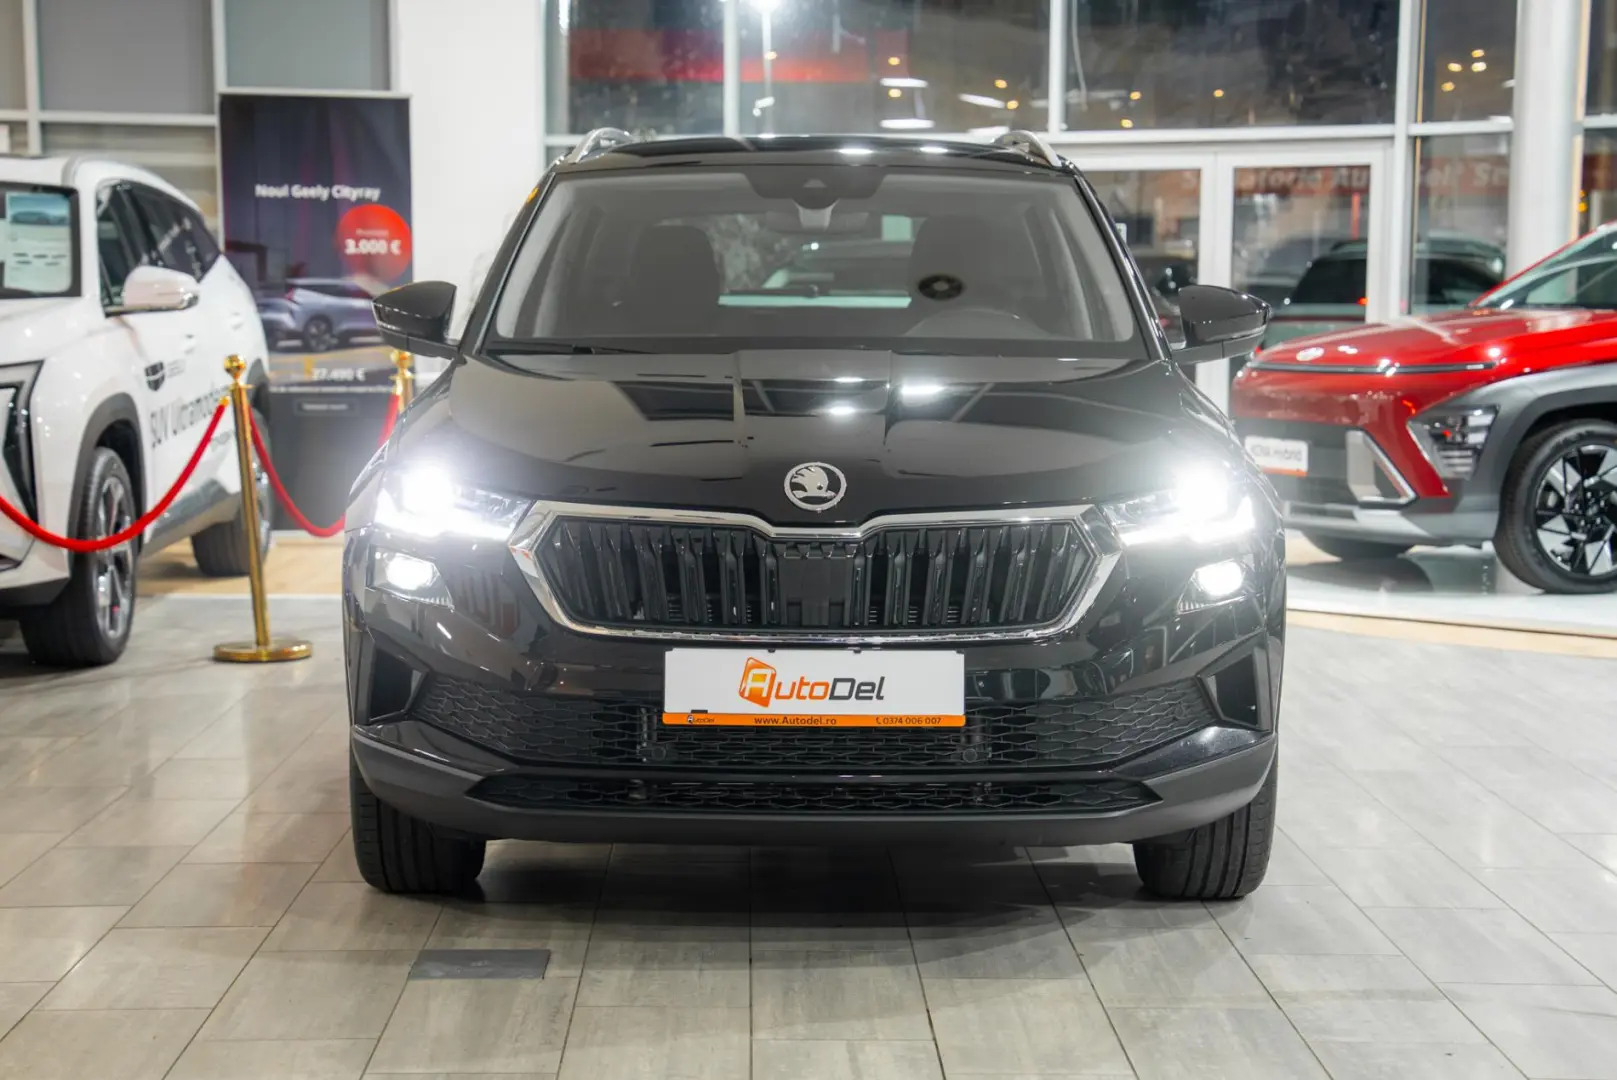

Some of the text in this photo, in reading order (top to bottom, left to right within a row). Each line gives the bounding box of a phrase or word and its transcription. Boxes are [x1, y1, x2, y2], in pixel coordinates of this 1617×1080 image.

[254, 183, 381, 202] Noul Geely Cityray
[344, 238, 402, 255] 3.000 €
[740, 663, 886, 703] AutoDel
[754, 715, 837, 726] www.Autodel.ro
[882, 716, 942, 725] 0374 006 007
